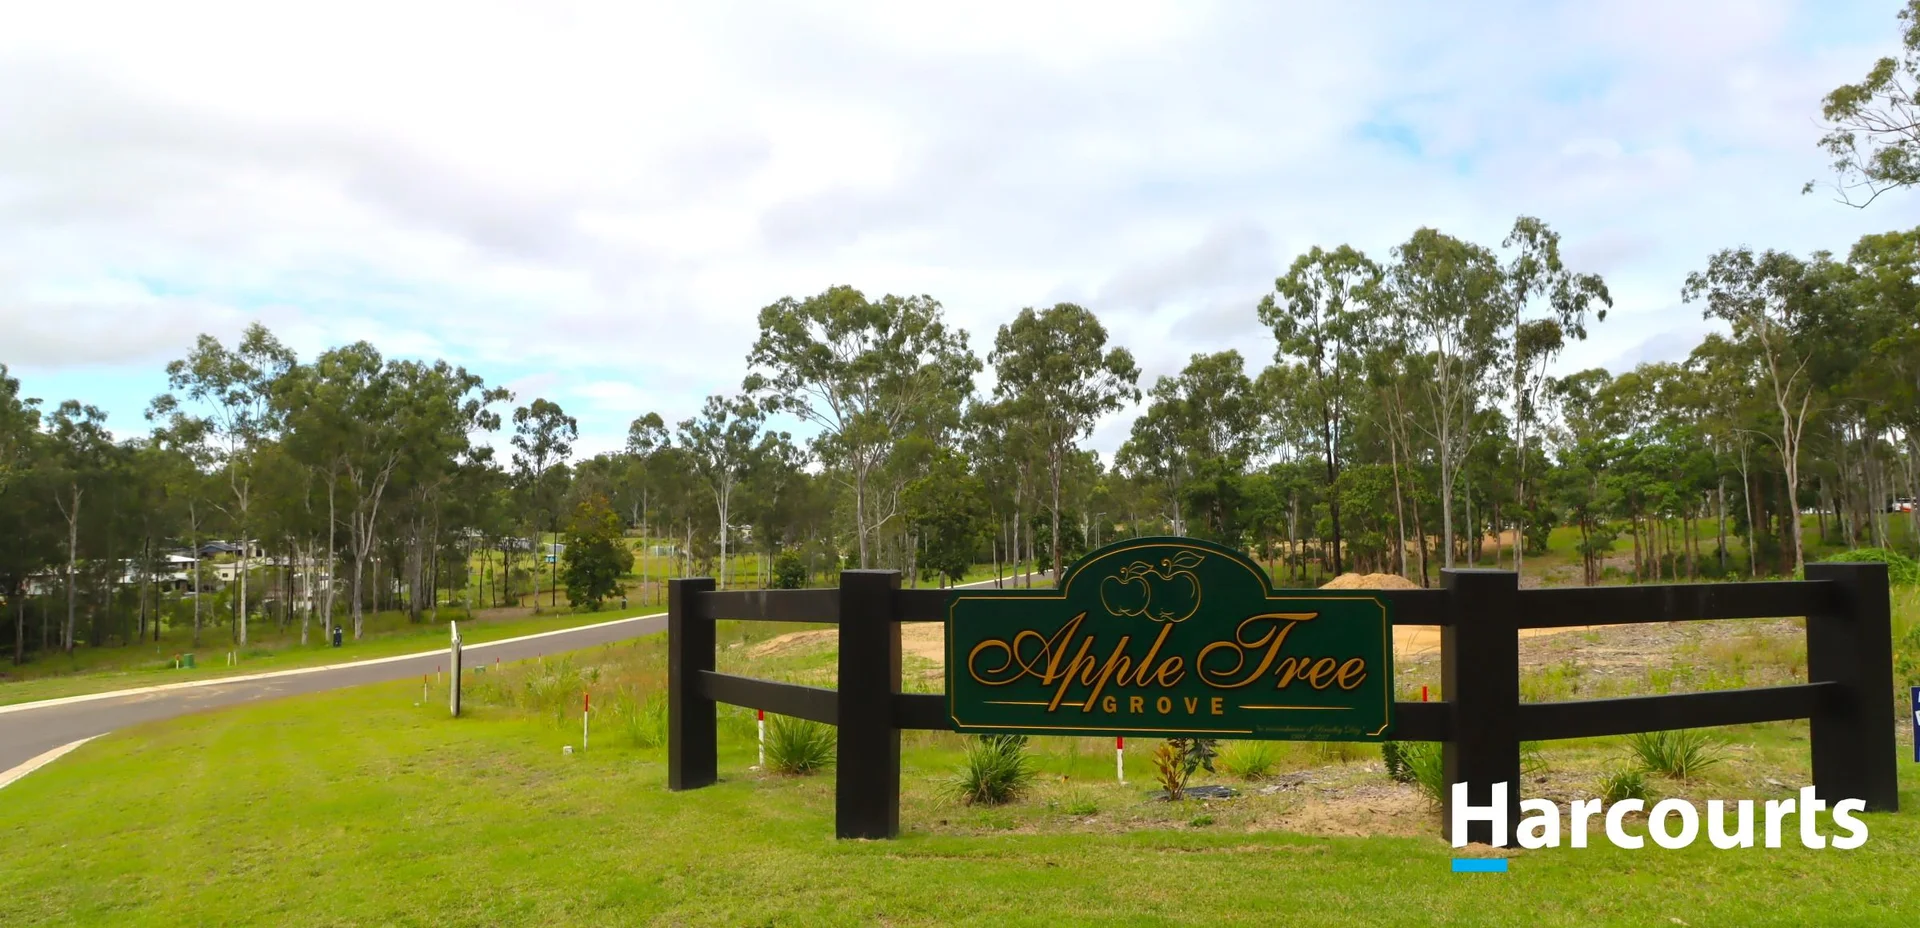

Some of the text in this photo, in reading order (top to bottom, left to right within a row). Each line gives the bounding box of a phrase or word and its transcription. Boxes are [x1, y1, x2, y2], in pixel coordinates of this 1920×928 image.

[968, 611, 1367, 712] Apple Tree
[1103, 696, 1224, 715] GROVE
